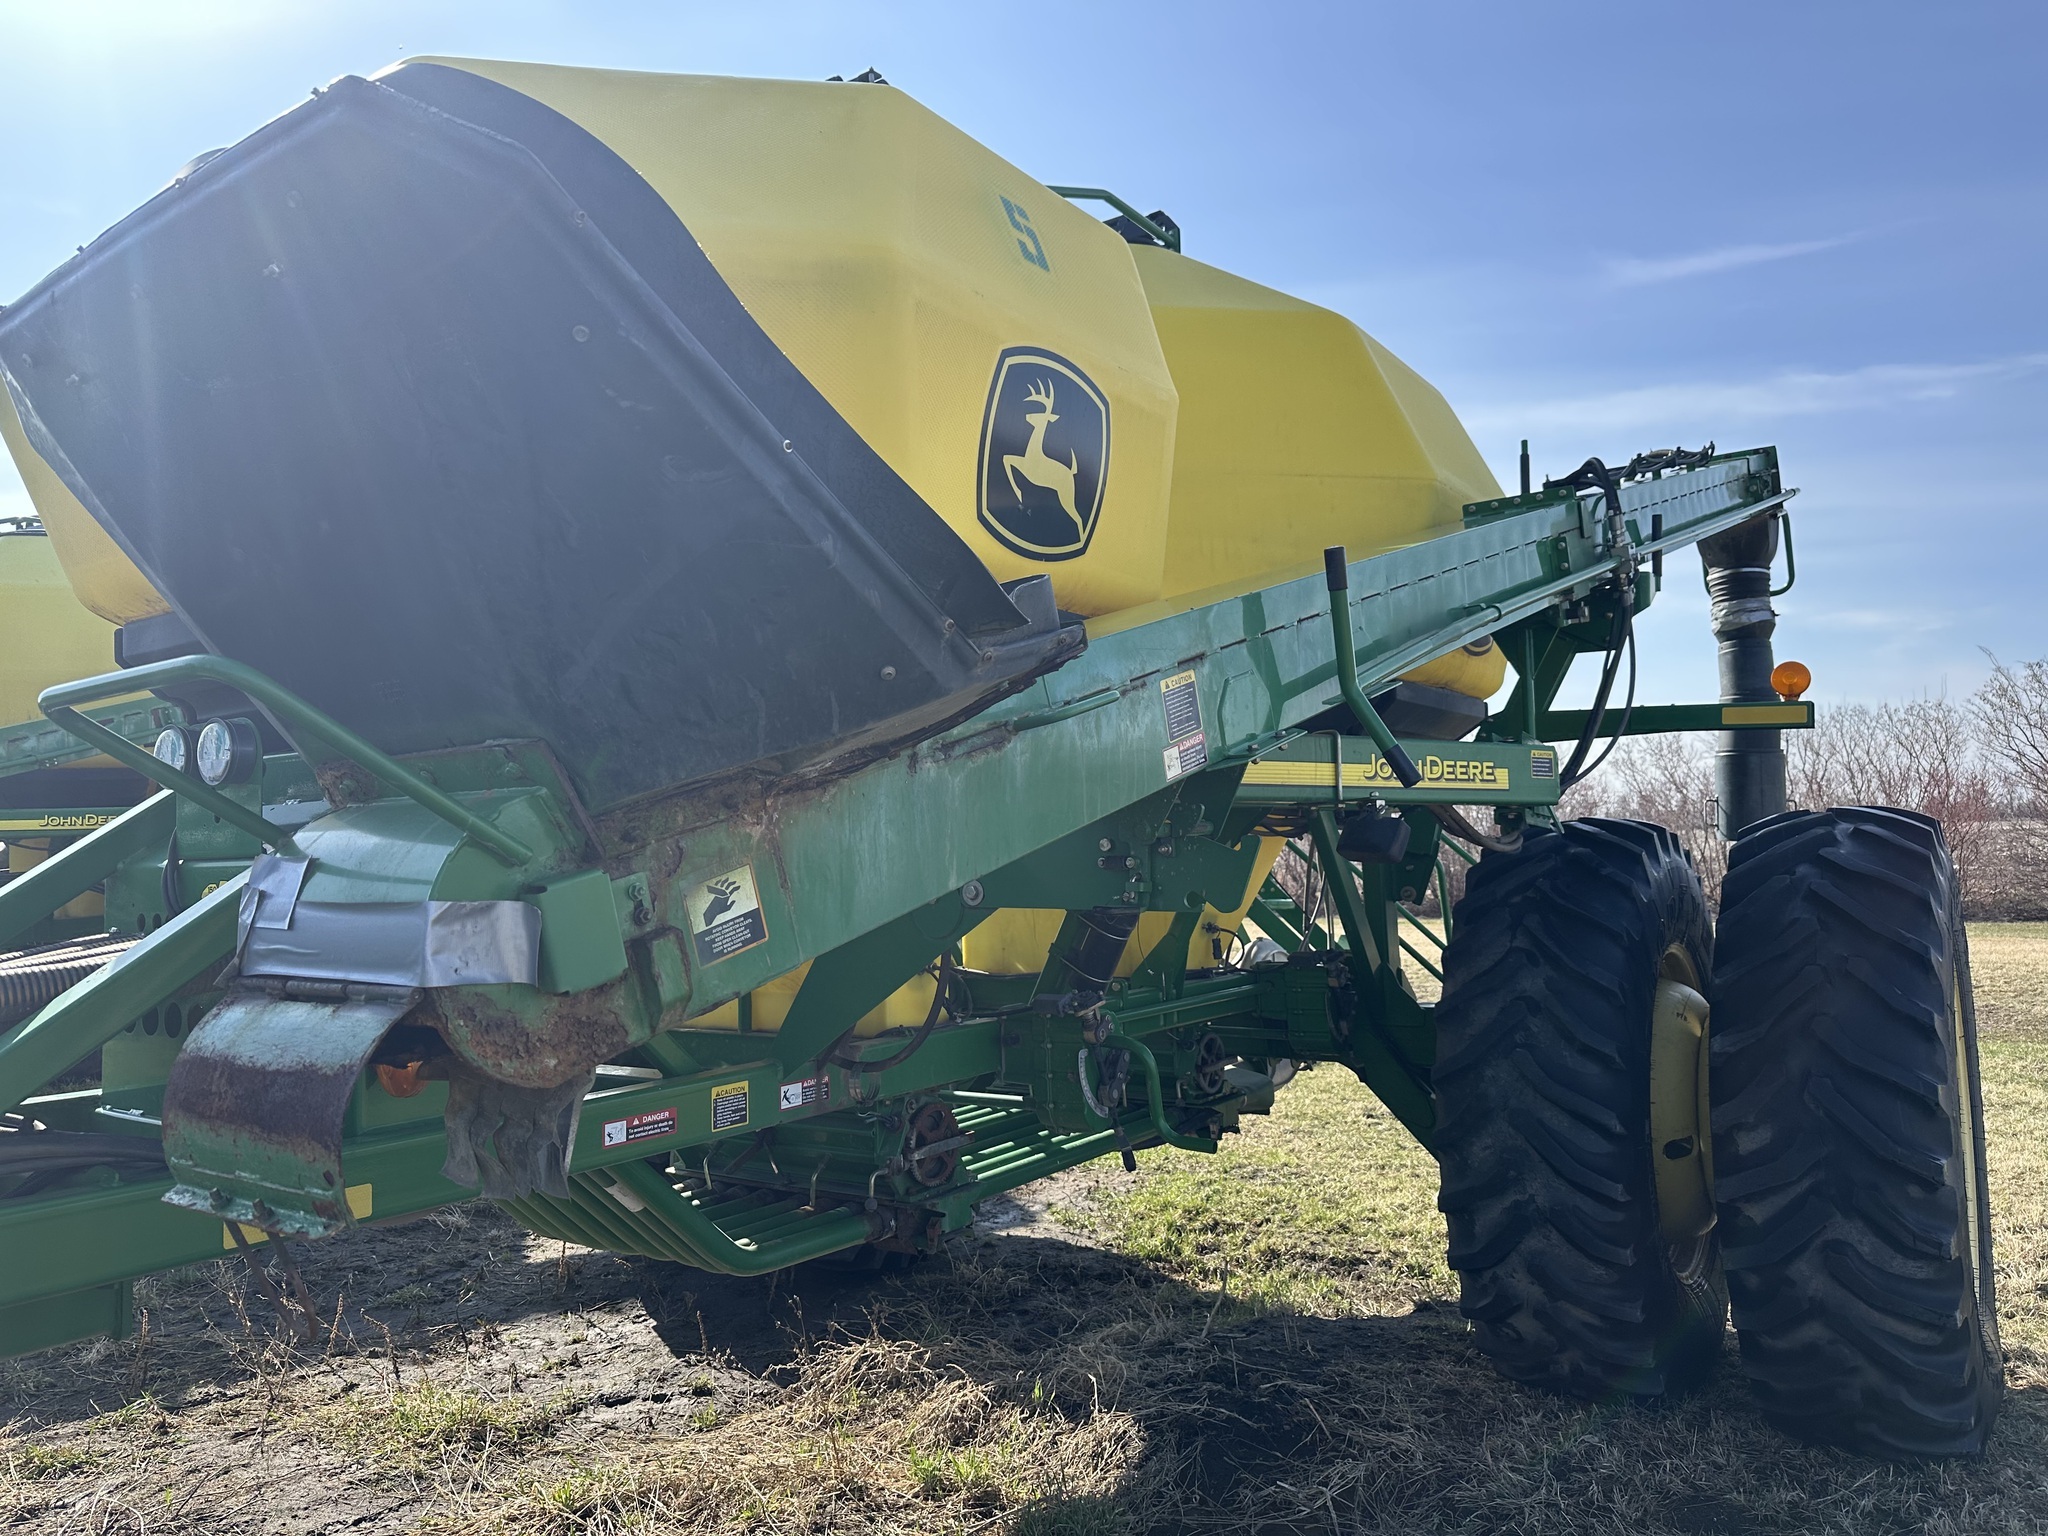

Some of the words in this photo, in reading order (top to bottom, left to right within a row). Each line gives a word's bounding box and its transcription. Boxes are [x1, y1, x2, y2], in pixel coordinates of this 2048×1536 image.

[1171, 674, 1193, 688] CAUTION
[1183, 733, 1204, 750] DANGER
[1426, 755, 1496, 783] DEERE
[39, 814, 82, 828] JOHN
[720, 1086, 746, 1097] CAUTION
[643, 1111, 670, 1123] DANGER
